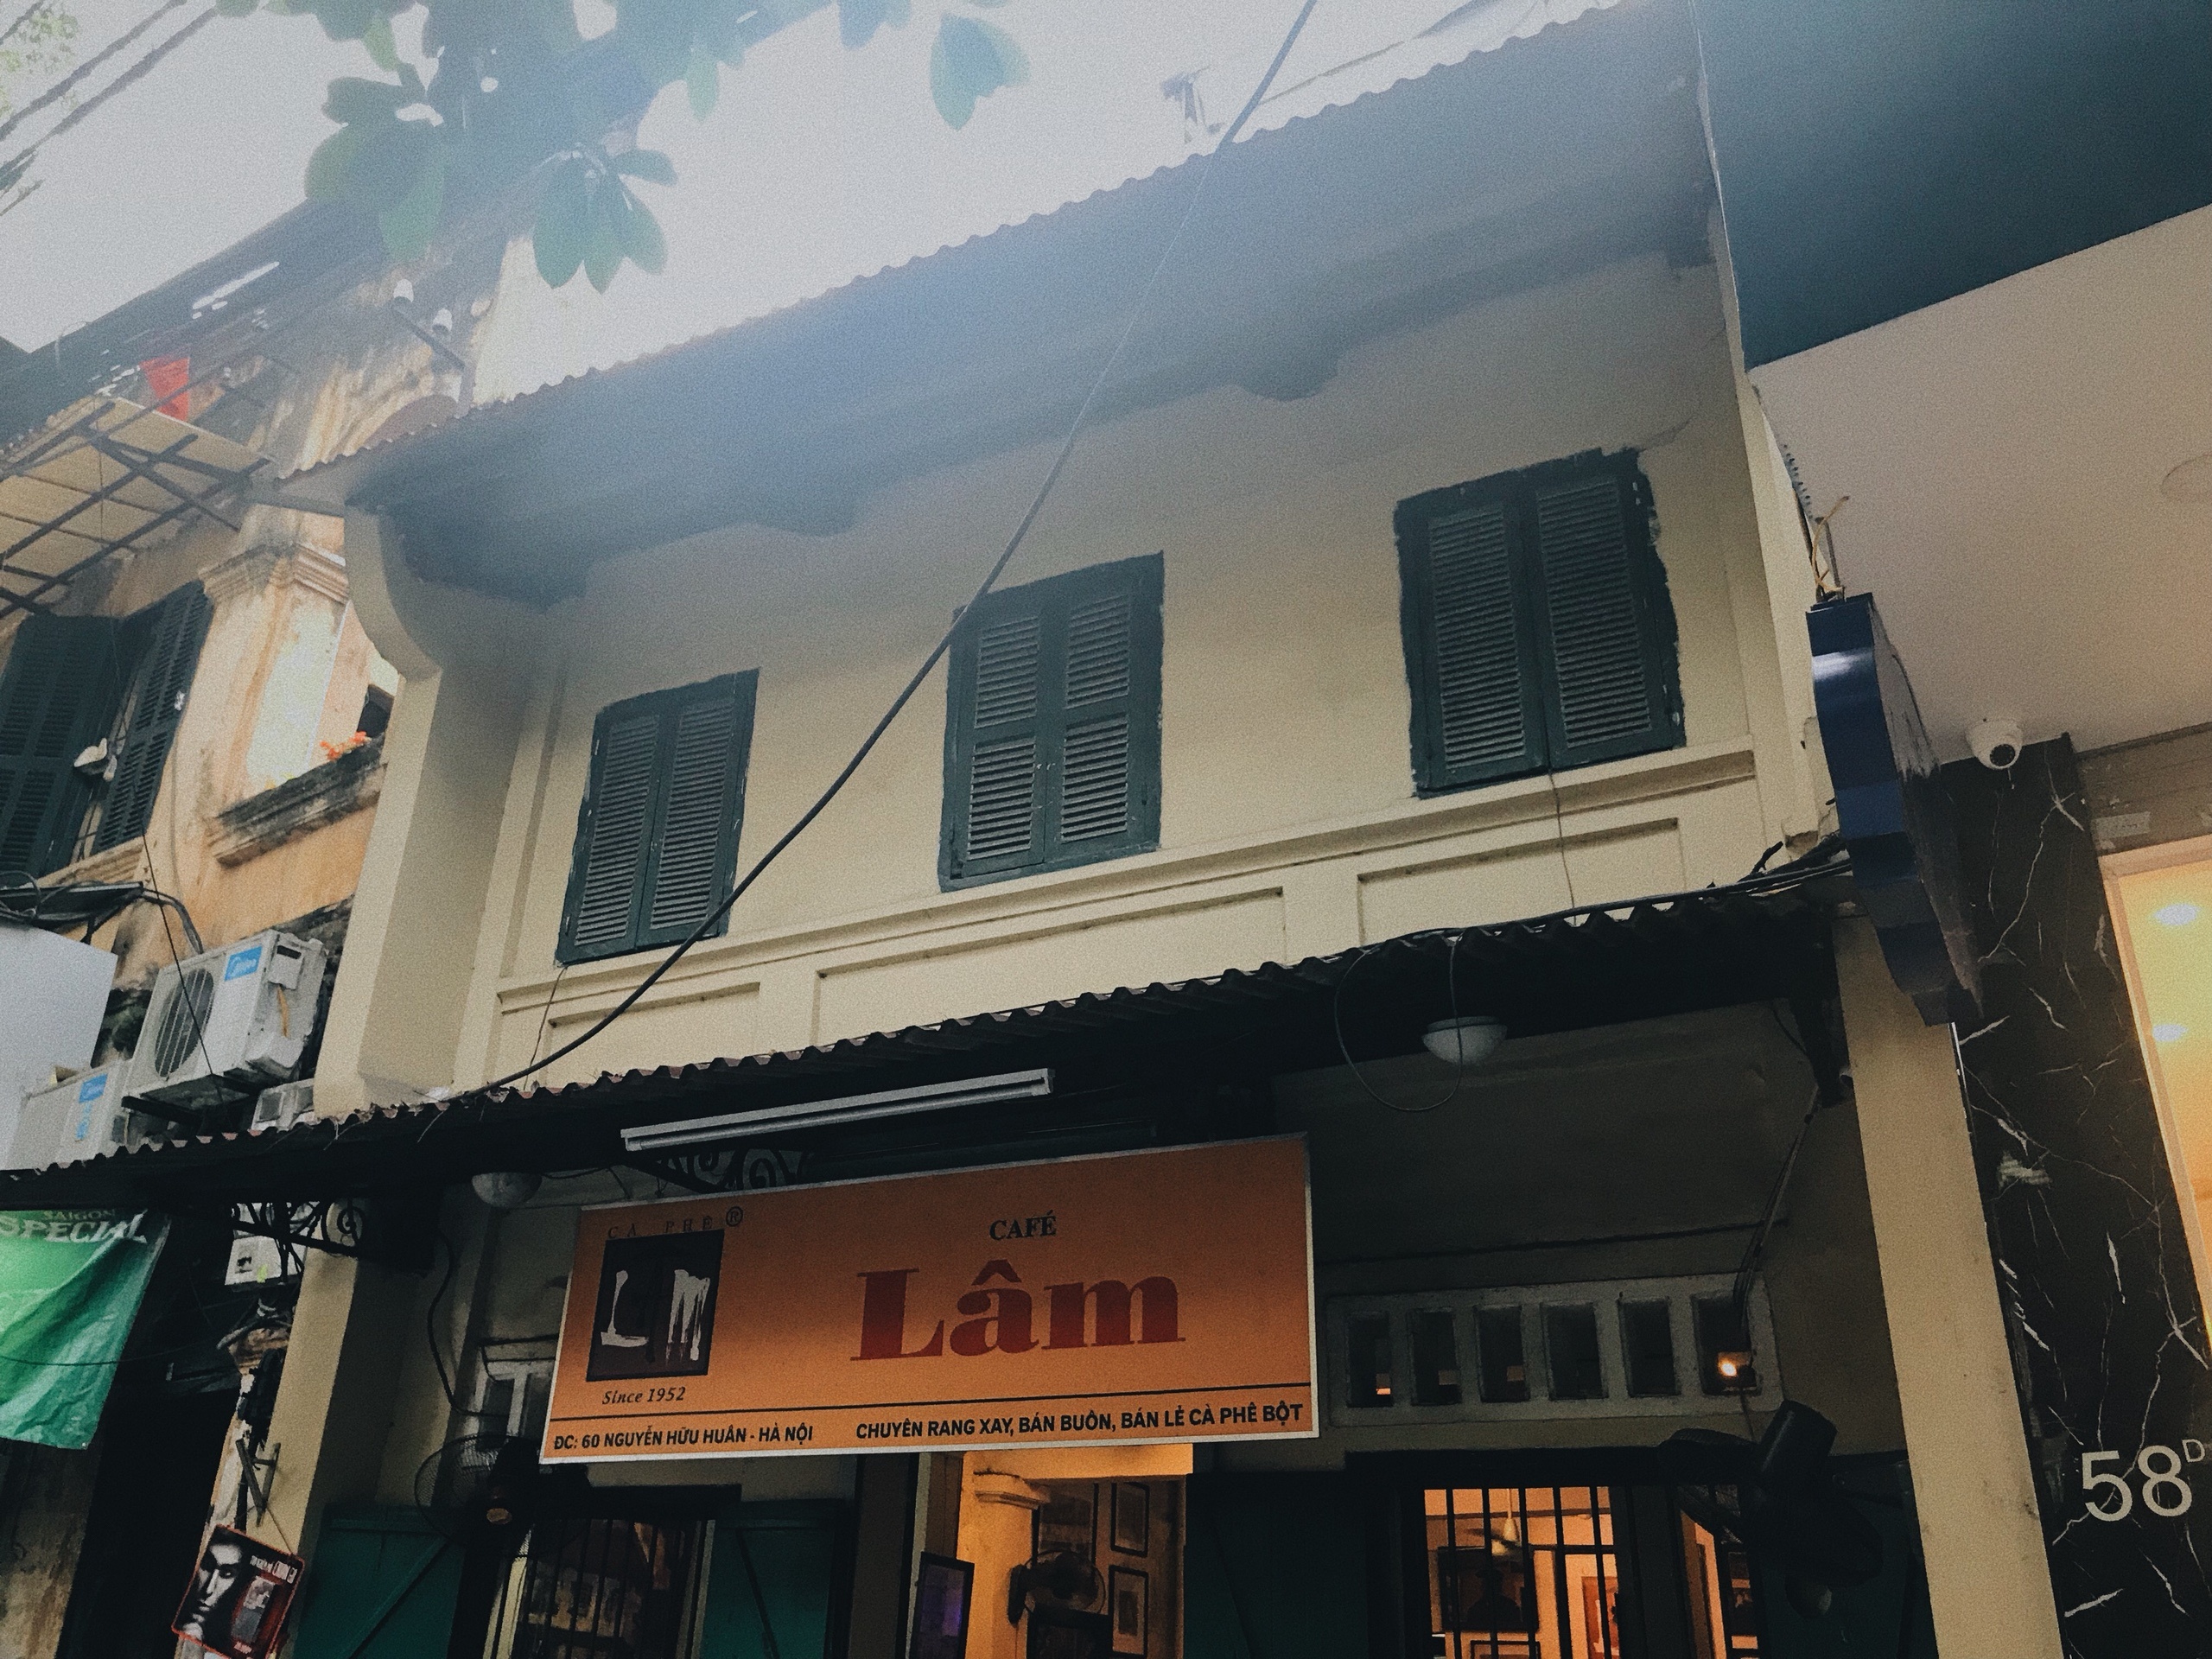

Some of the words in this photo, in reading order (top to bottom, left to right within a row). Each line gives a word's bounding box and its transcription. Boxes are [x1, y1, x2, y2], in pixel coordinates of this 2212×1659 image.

[0, 1211, 148, 1243] SPECIAL
[989, 1210, 1056, 1241] CAFÉ
[850, 1259, 1186, 1361] Lâm
[602, 1390, 643, 1405] Since
[647, 1387, 687, 1402] 1952
[856, 1417, 923, 1439] CHUYÊN
[928, 1419, 975, 1436] RANG
[979, 1417, 1014, 1437] XAY,
[1019, 1412, 1055, 1433] BÁN
[1060, 1409, 1116, 1432] BUÔN,
[1121, 1407, 1159, 1429] BÁN
[1164, 1404, 1185, 1427] LẺ
[1189, 1404, 1215, 1426] CÀ
[1220, 1402, 1257, 1424] PHÊ
[1262, 1400, 1303, 1426] BỘT
[554, 1434, 577, 1450] ĐC:
[582, 1433, 601, 1449] 60
[604, 1426, 662, 1447] NGUYỄN
[666, 1426, 699, 1445] HỮU
[702, 1424, 747, 1444] HUÂN
[759, 1422, 780, 1442] HÀ
[785, 1422, 813, 1446] NỘI
